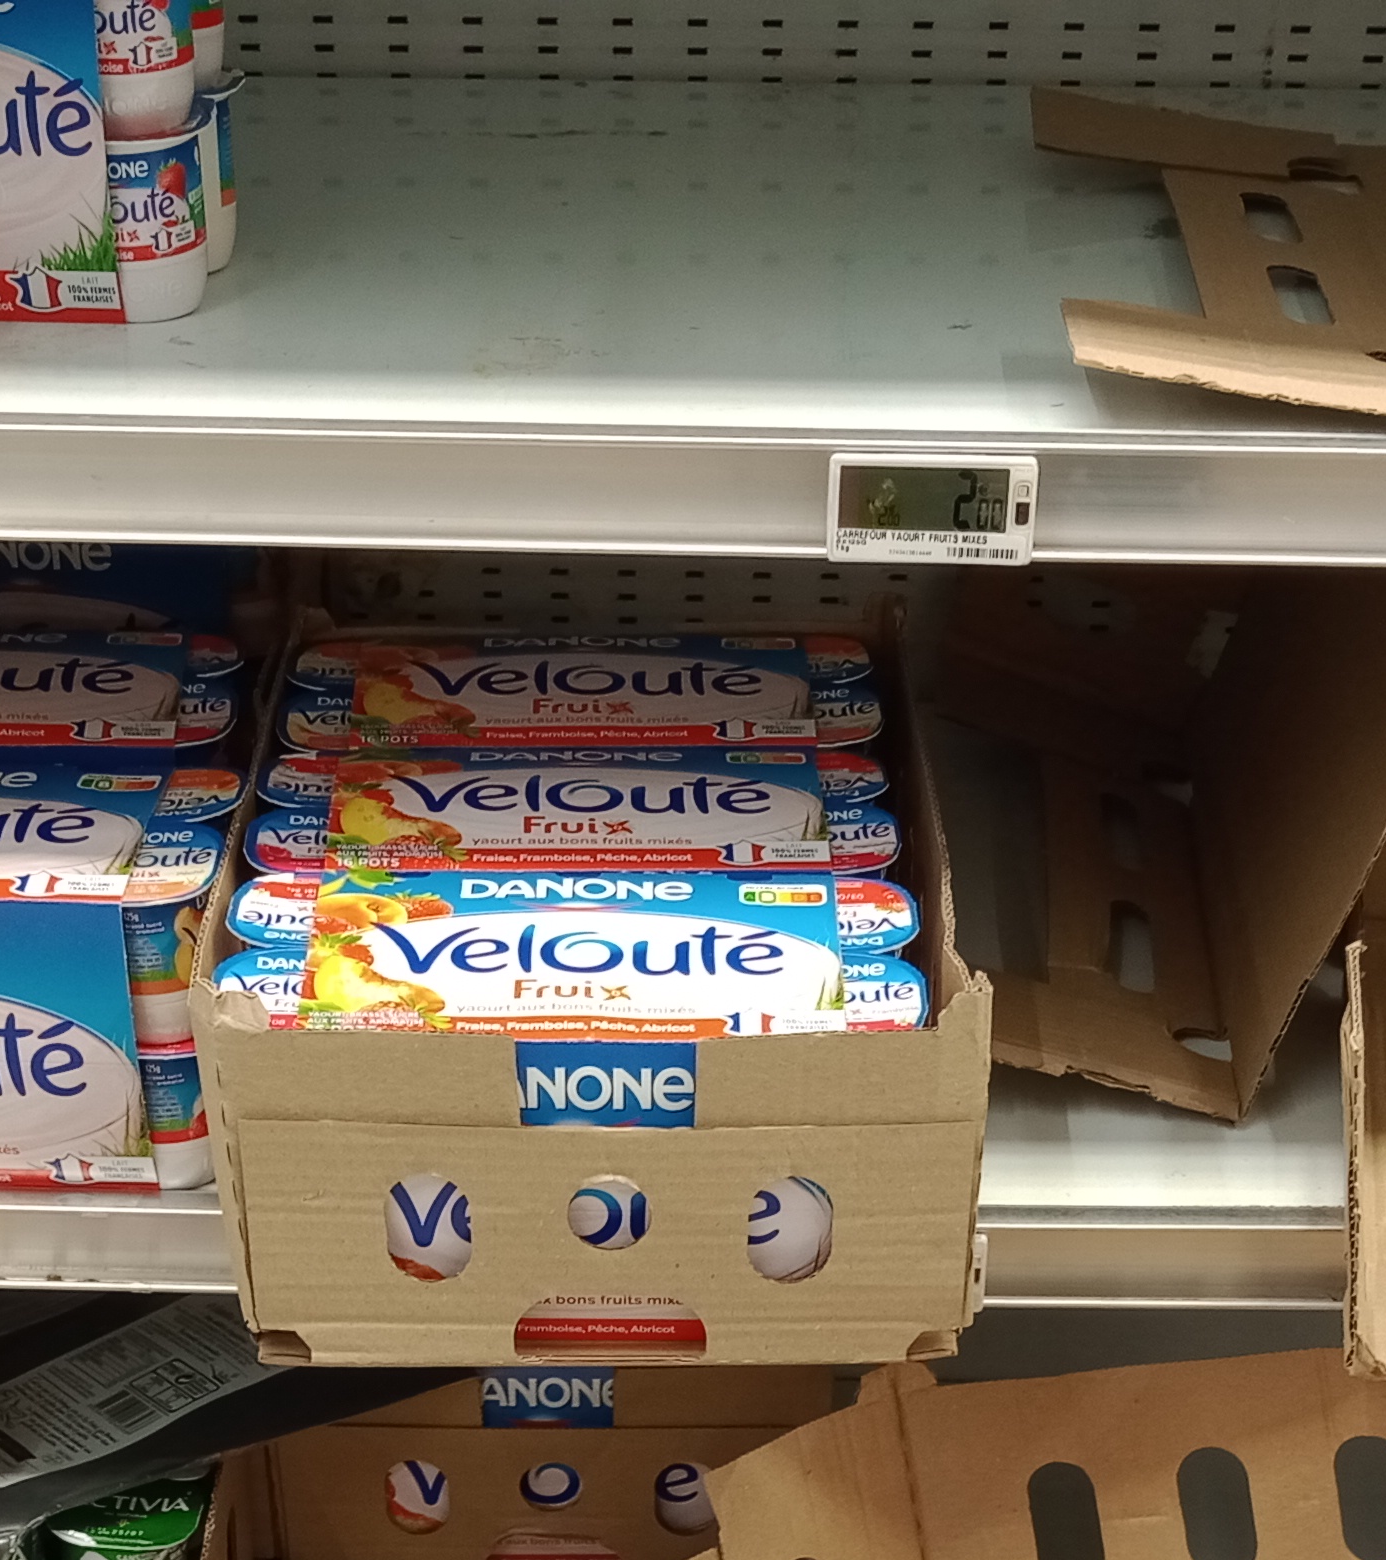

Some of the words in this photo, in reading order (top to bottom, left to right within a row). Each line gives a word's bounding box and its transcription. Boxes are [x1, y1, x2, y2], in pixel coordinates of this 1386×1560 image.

[891, 532, 925, 542] YAOURT
[529, 728, 595, 739] Framboise,
[640, 728, 688, 738] Abricot
[523, 815, 633, 836] Fruix
[337, 858, 356, 867] 16
[361, 858, 400, 868] POTS
[472, 853, 515, 865] Fraise,
[519, 852, 592, 865] Framboise,
[597, 852, 639, 864] Pêche,
[644, 852, 692, 863] Abricot
[456, 1021, 505, 1033] Fraise,
[507, 1021, 588, 1032] Framboise,
[641, 1021, 696, 1033] Abricot
